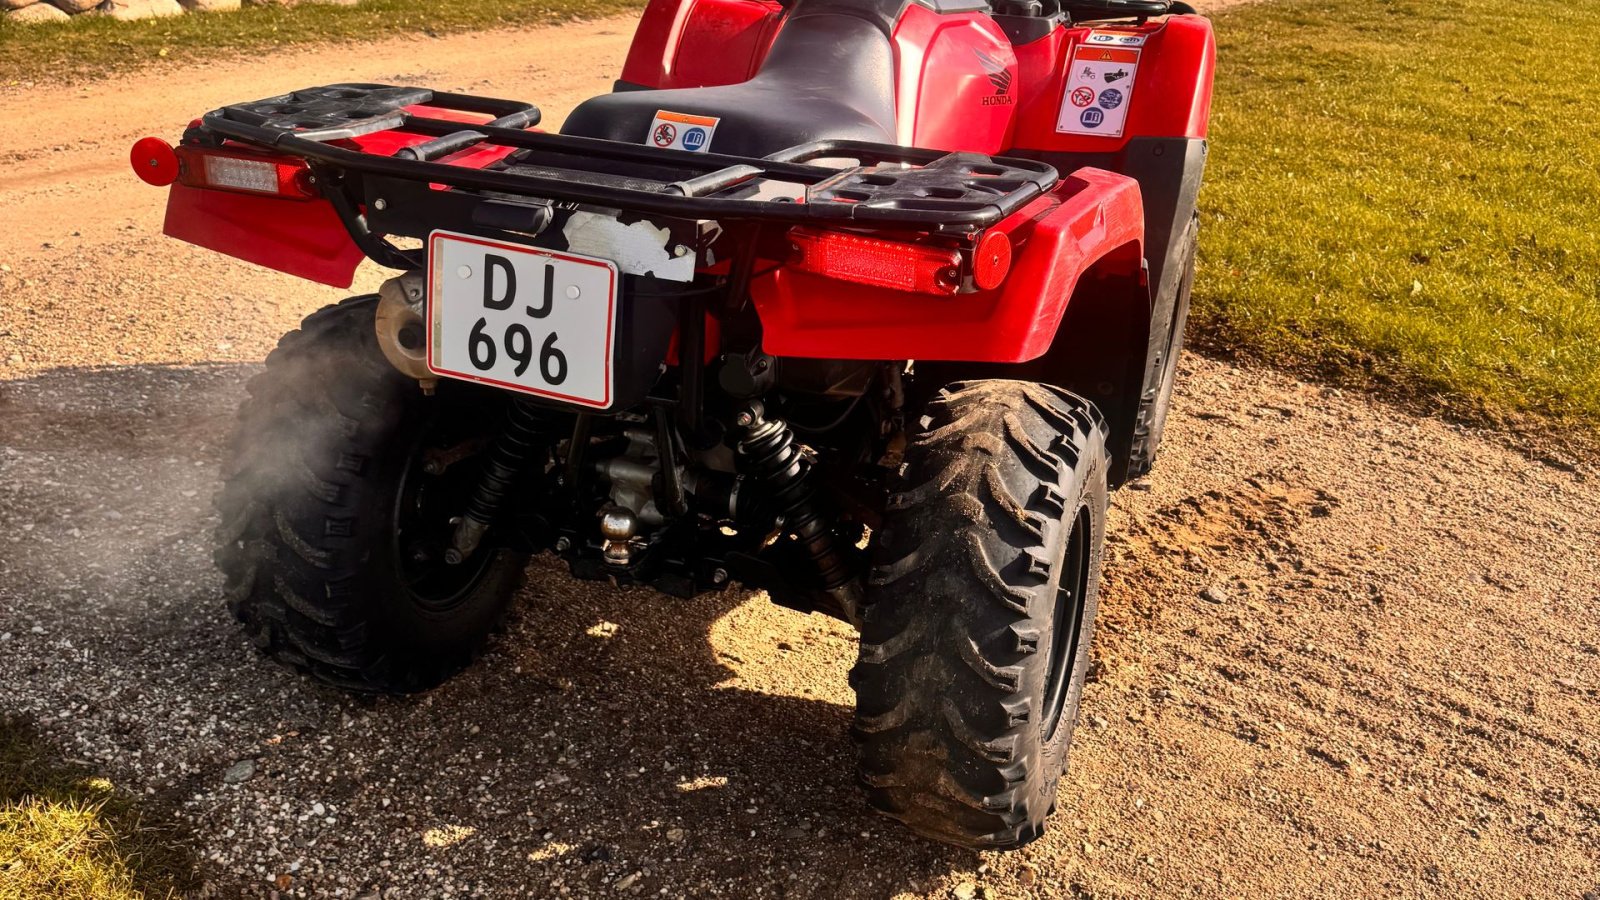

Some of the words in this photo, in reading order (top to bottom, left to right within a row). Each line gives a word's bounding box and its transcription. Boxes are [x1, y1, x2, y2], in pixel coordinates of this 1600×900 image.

[982, 95, 1012, 106] HONDA
[483, 253, 555, 319] DJ
[468, 317, 568, 386] 696
